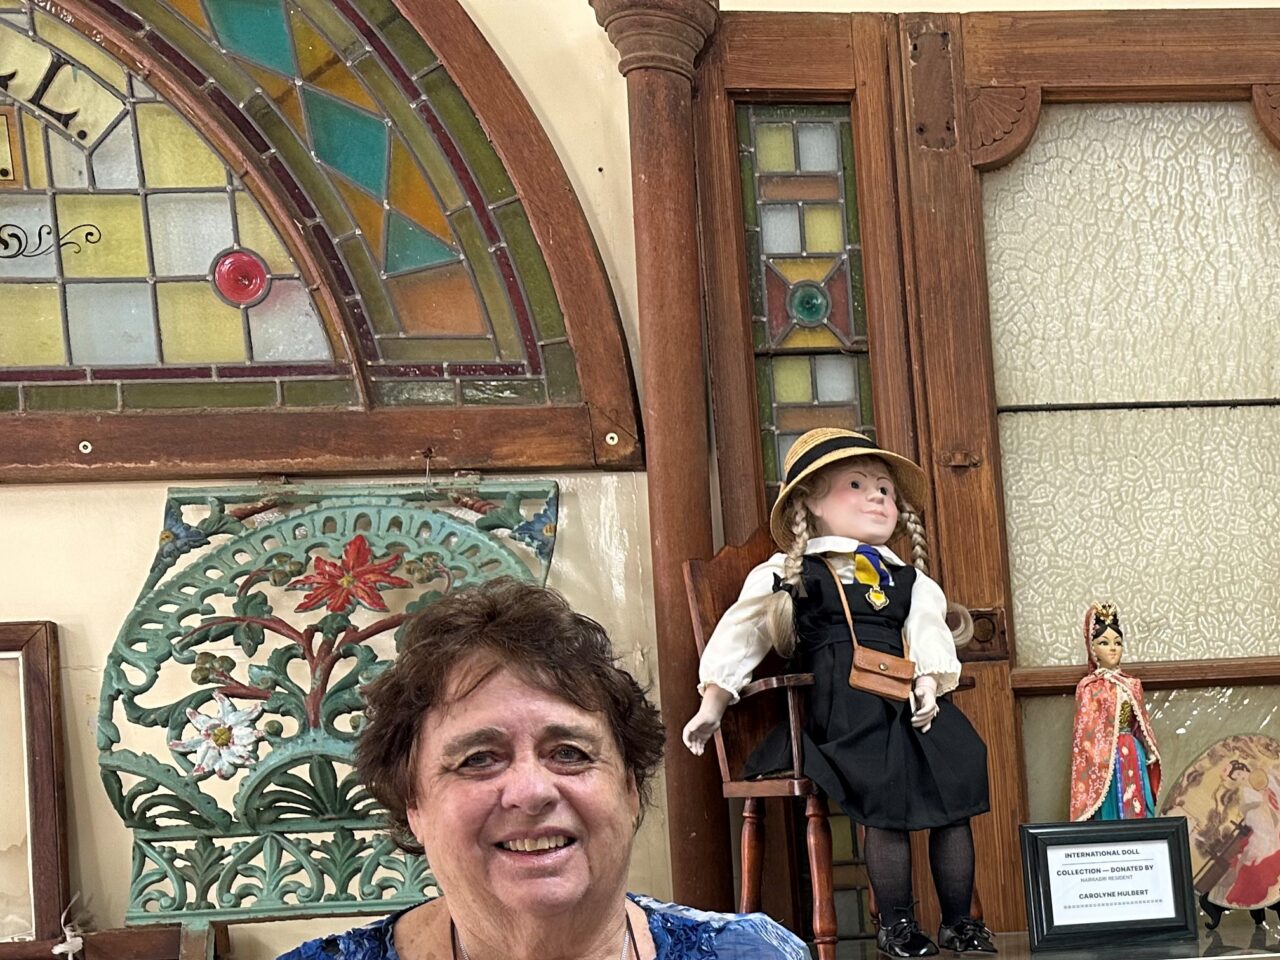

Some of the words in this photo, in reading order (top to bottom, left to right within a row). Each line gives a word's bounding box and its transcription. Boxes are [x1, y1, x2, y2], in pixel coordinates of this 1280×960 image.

[1064, 850, 1121, 859] INTERNATIONAL
[1056, 867, 1102, 876] COLLECTION
[1110, 865, 1144, 874] DONATED
[1078, 891, 1116, 900] CAROLYNE
[1117, 889, 1149, 897] HULBERT
